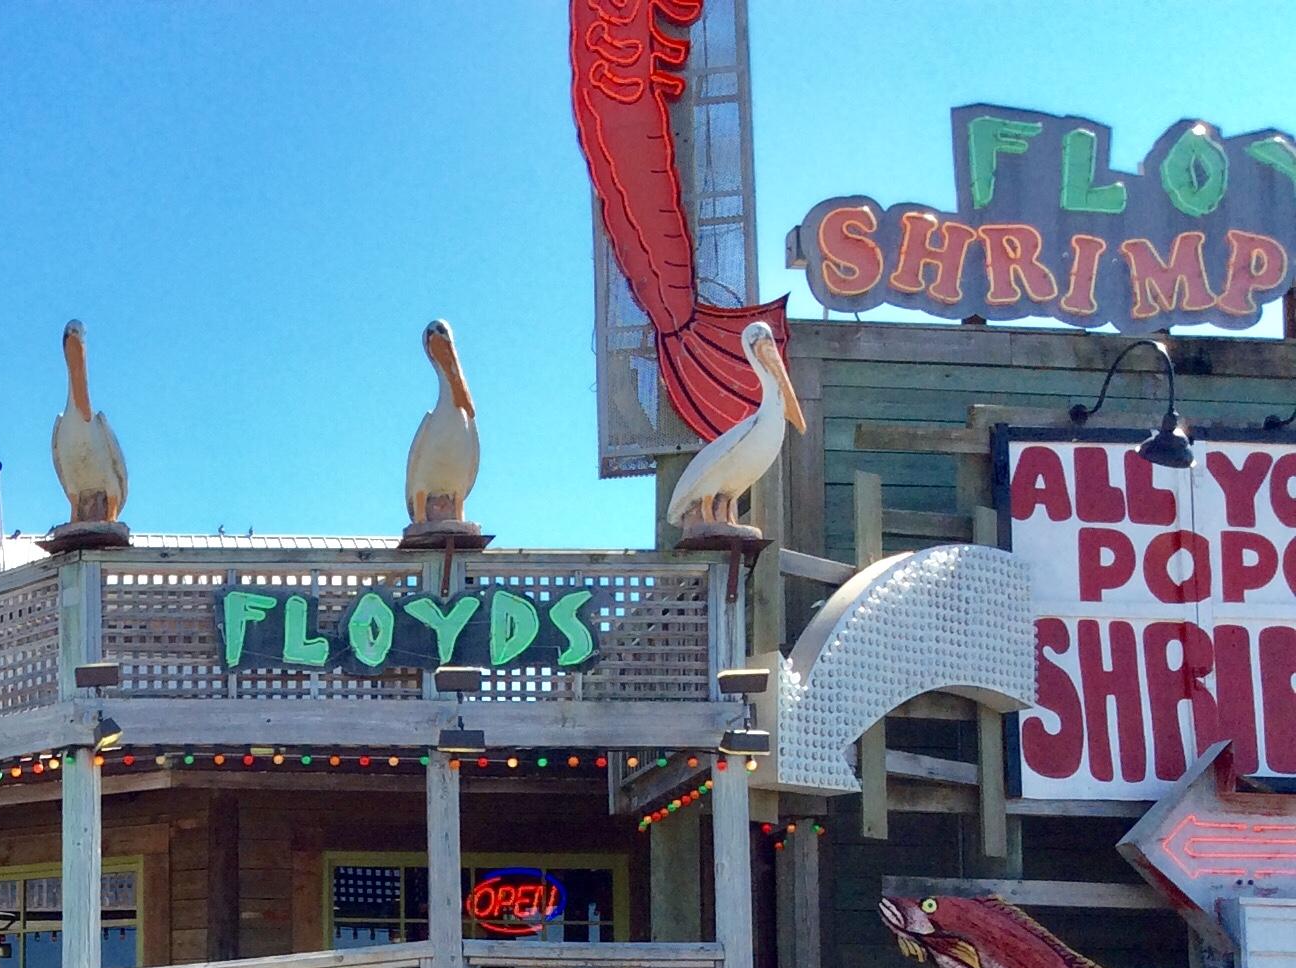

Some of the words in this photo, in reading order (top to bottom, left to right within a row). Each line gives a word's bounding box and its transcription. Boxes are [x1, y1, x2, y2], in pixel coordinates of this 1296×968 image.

[817, 205, 1288, 319] SHRIMP
[1009, 446, 1177, 527] ALL
[1078, 527, 1296, 604] POP
[223, 590, 595, 668] FLOYDS
[472, 884, 559, 918] OPEN
